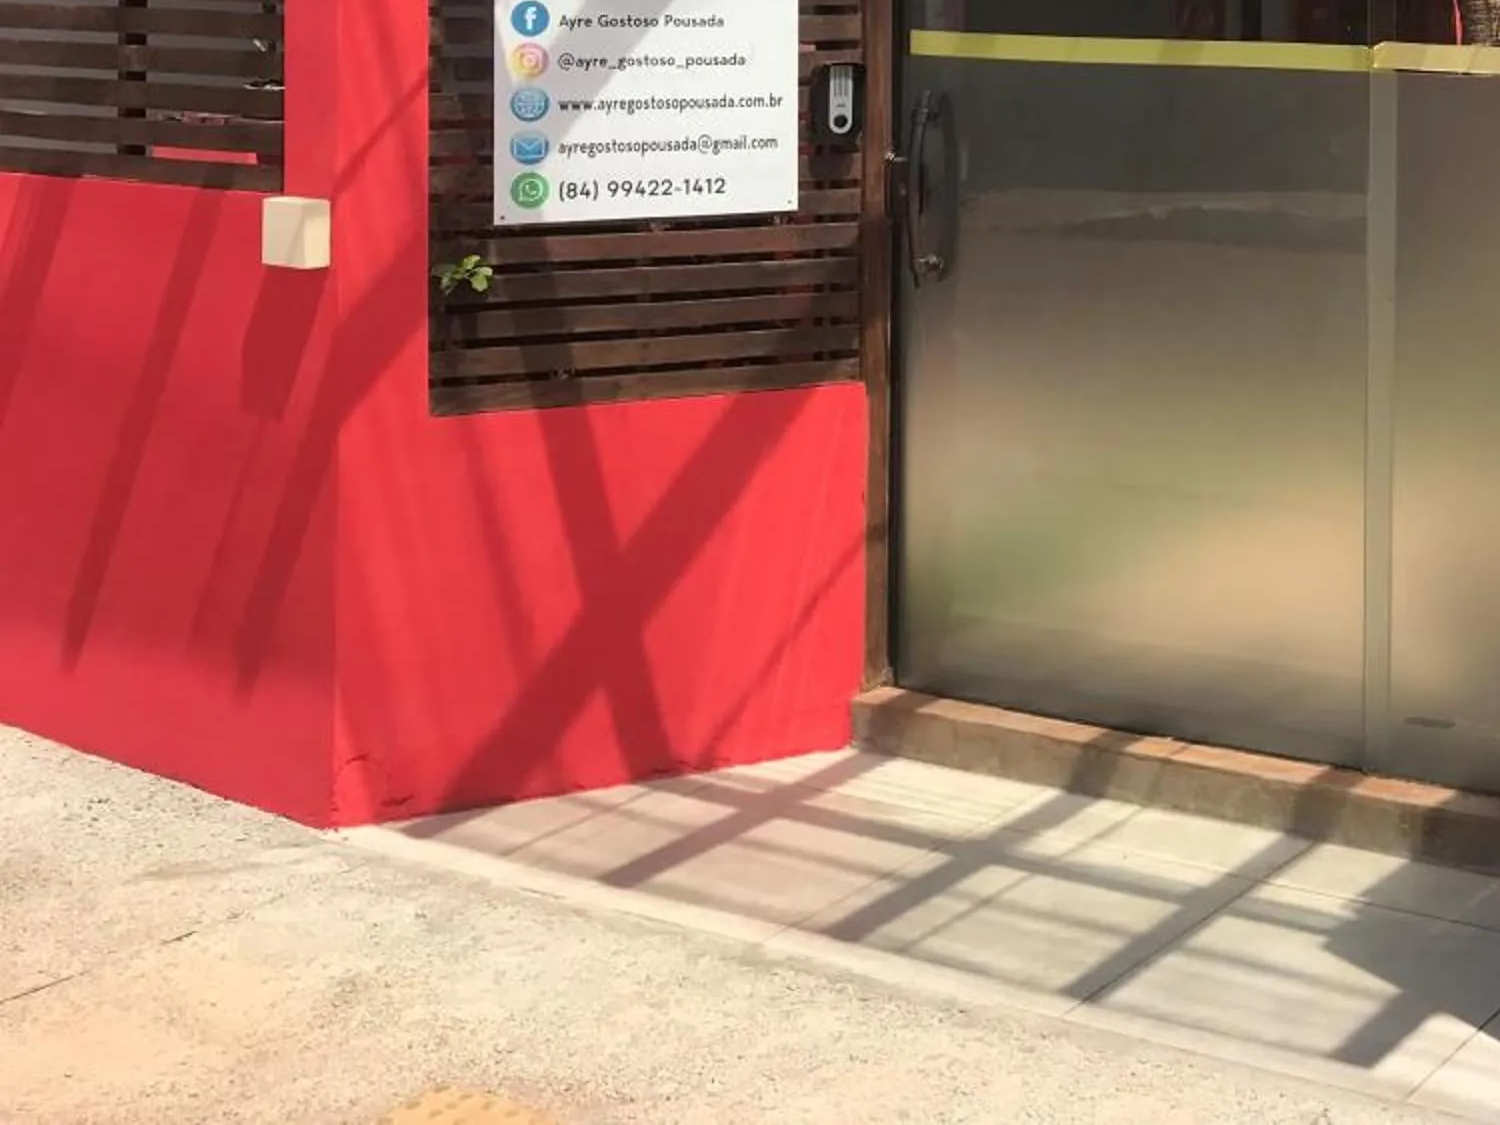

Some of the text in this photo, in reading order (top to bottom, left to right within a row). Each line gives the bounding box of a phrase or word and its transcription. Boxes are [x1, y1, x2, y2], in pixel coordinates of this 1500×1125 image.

[559, 14, 725, 30] Ayre Gostoso Pousada
[558, 52, 747, 71] @ayre_gostoso_pousada
[558, 93, 783, 115] www.ayregostosopousada.com.br
[558, 134, 778, 159] ayregostosopousada@gmail.com
[559, 177, 727, 202] (84) 99422-1412
